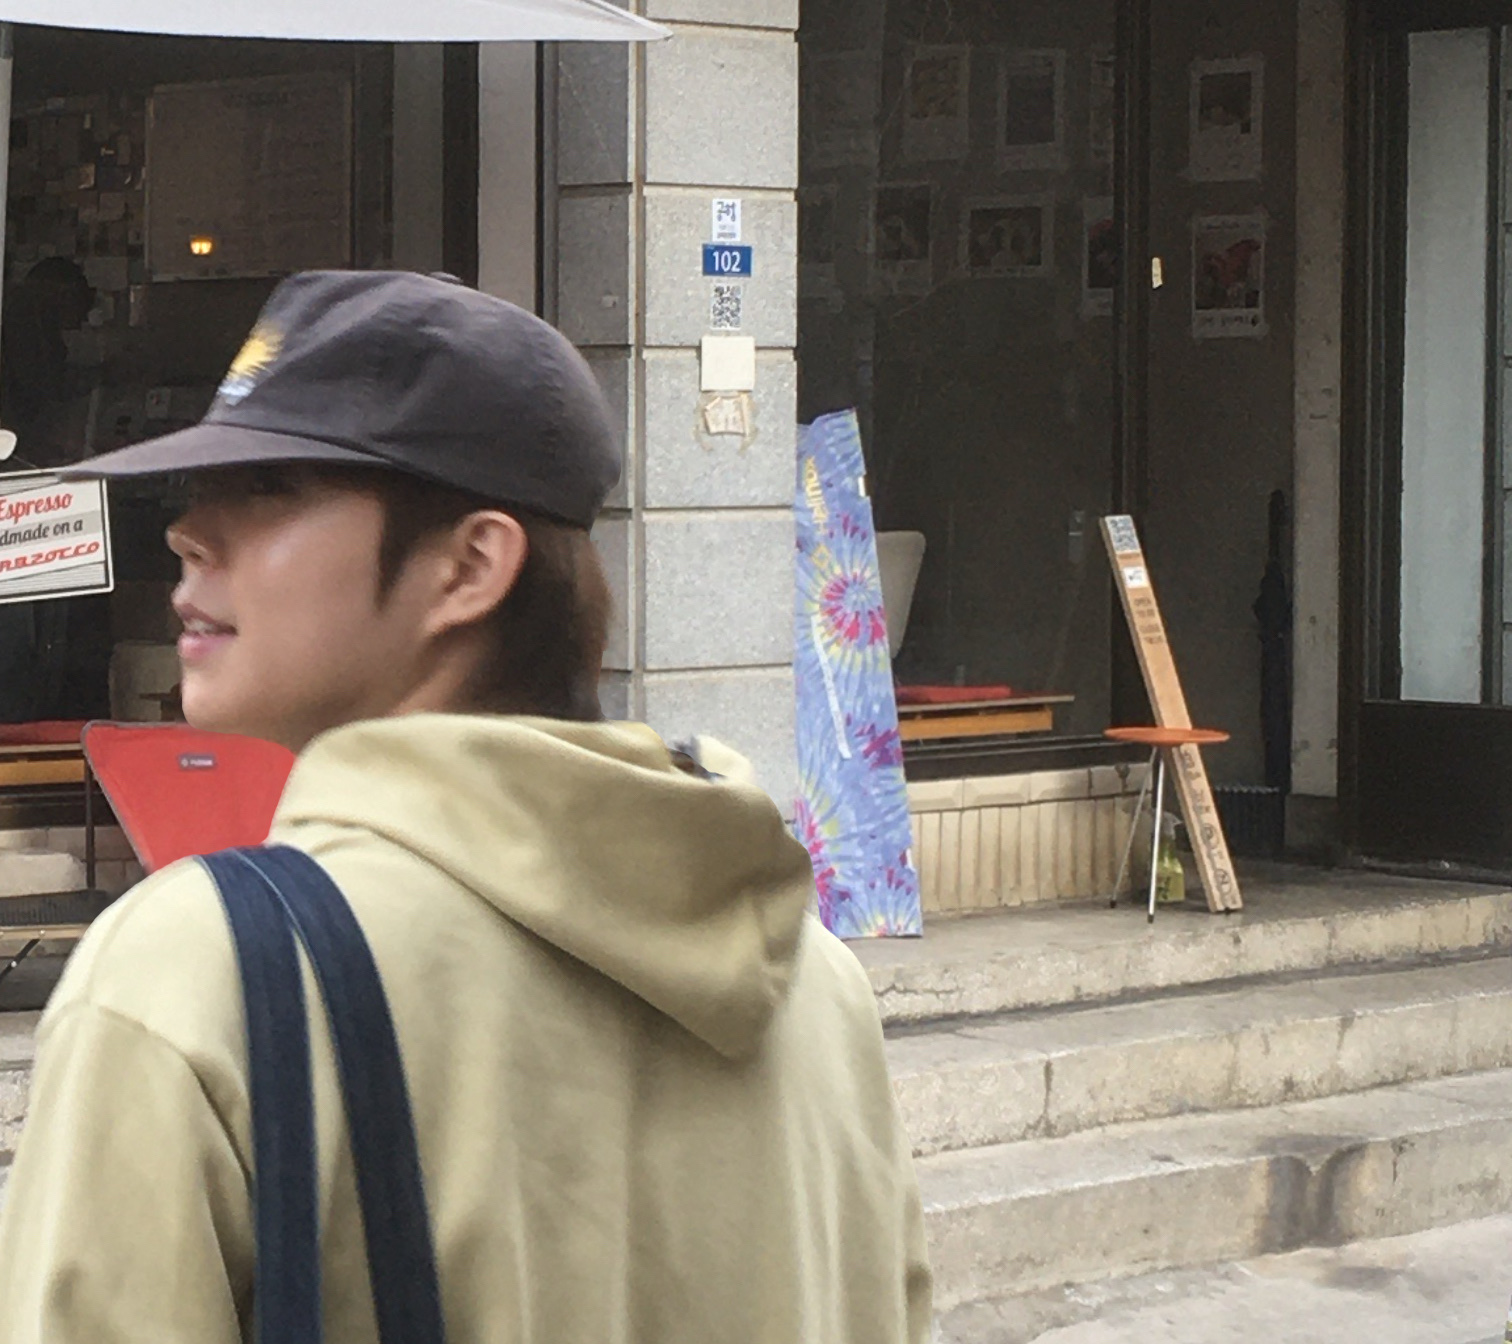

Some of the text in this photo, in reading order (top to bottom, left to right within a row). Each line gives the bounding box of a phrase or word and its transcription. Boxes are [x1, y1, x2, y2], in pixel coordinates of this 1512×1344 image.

[712, 250, 742, 273] 102
[52, 523, 71, 536] on
[72, 519, 84, 533] a
